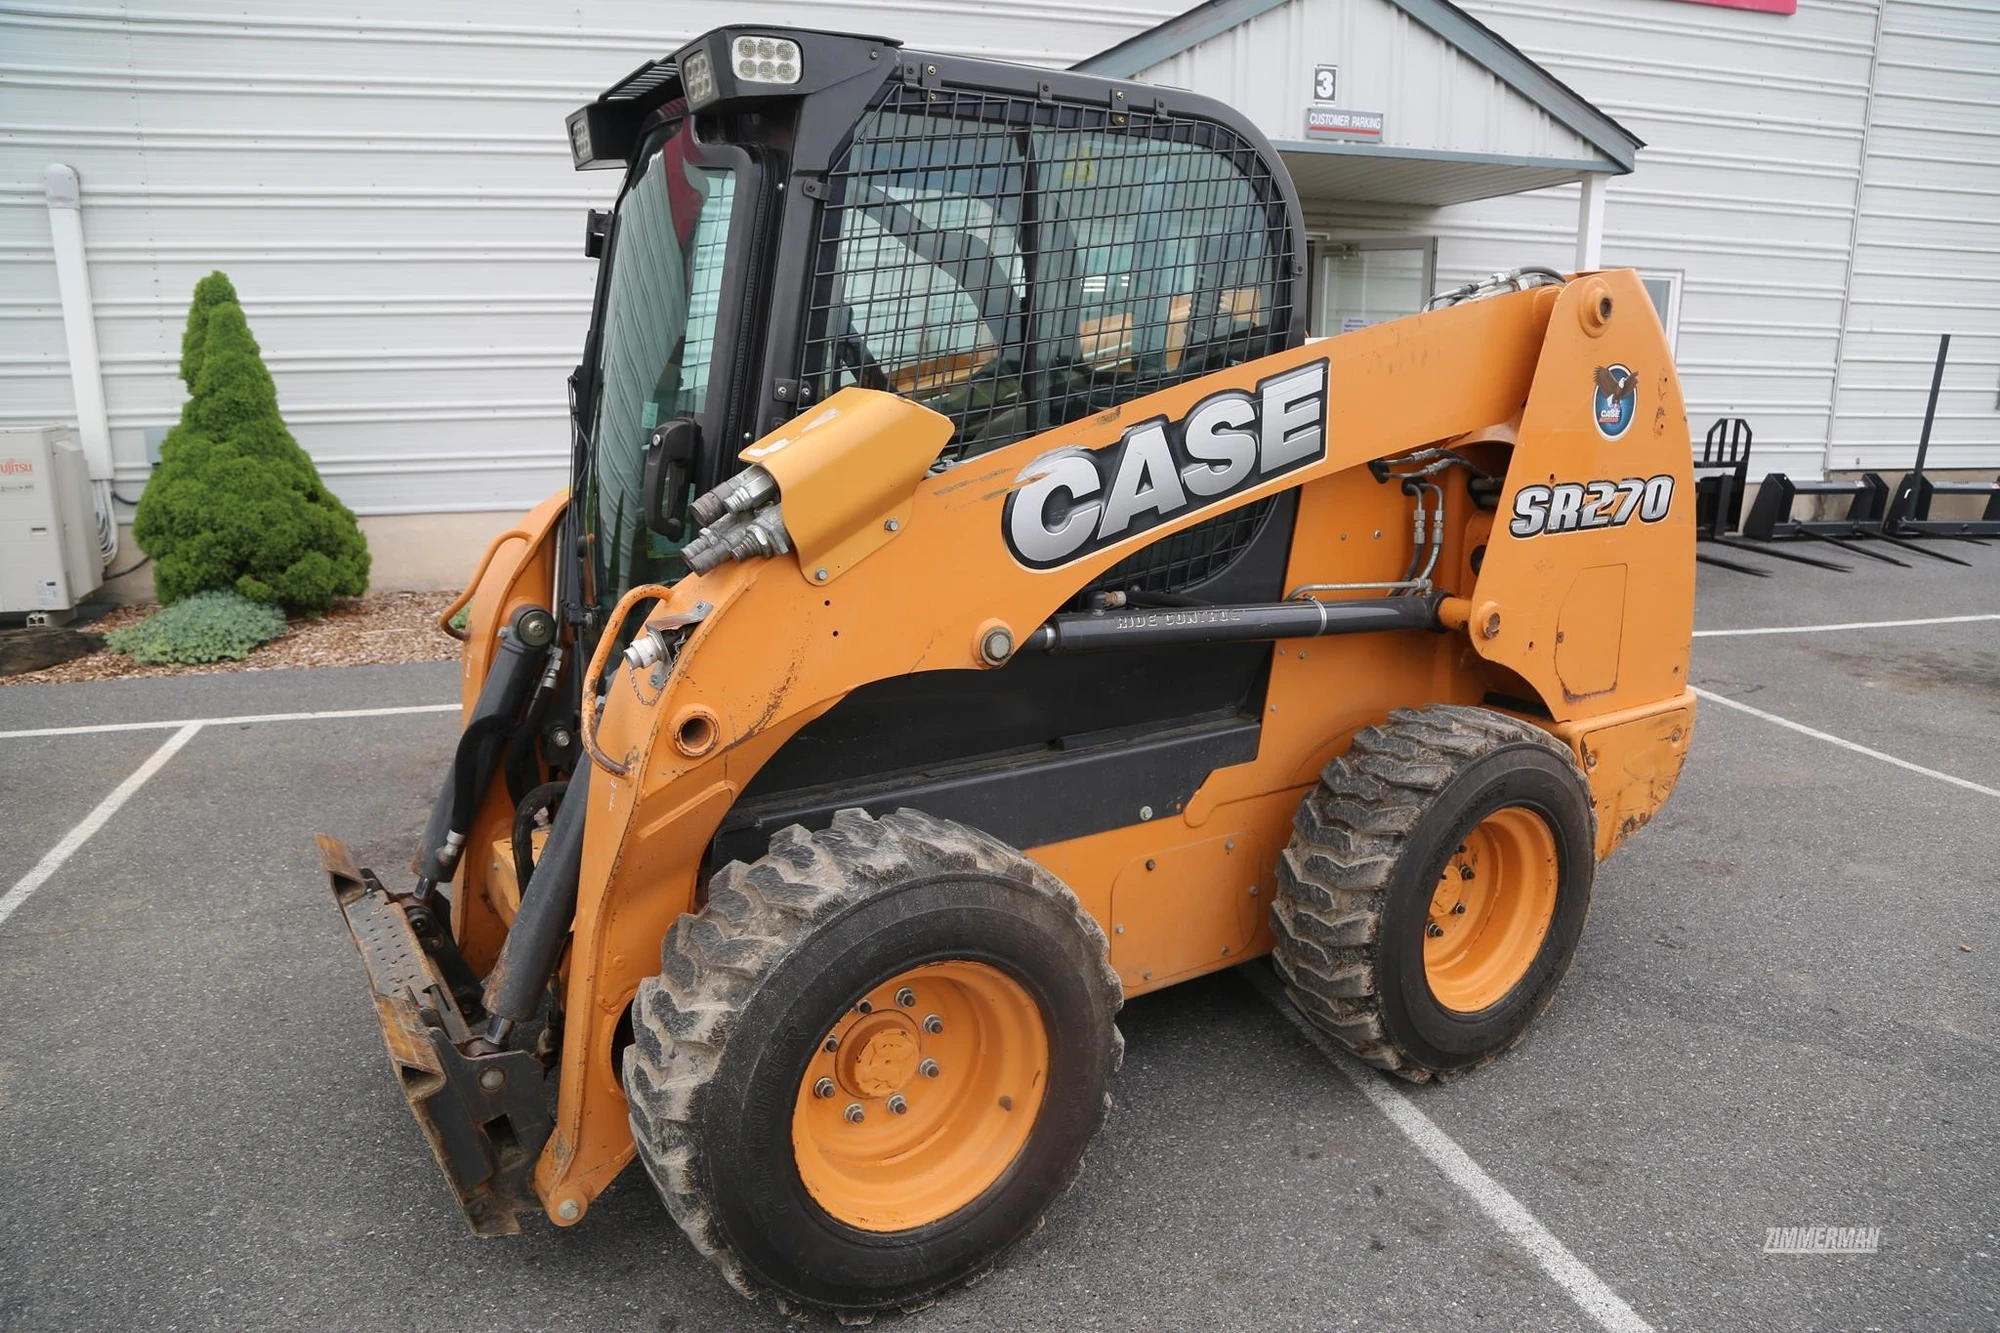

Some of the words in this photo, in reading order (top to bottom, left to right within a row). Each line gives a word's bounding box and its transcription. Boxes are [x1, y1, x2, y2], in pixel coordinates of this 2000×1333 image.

[1316, 70, 1335, 98] 3
[1309, 113, 1350, 126] CUSTOMER
[1351, 116, 1382, 129] PARKING
[0, 459, 32, 475] UJITSU
[1006, 362, 1328, 567] CASE
[1509, 475, 1675, 538] SR270
[1116, 613, 1158, 629] RIDE
